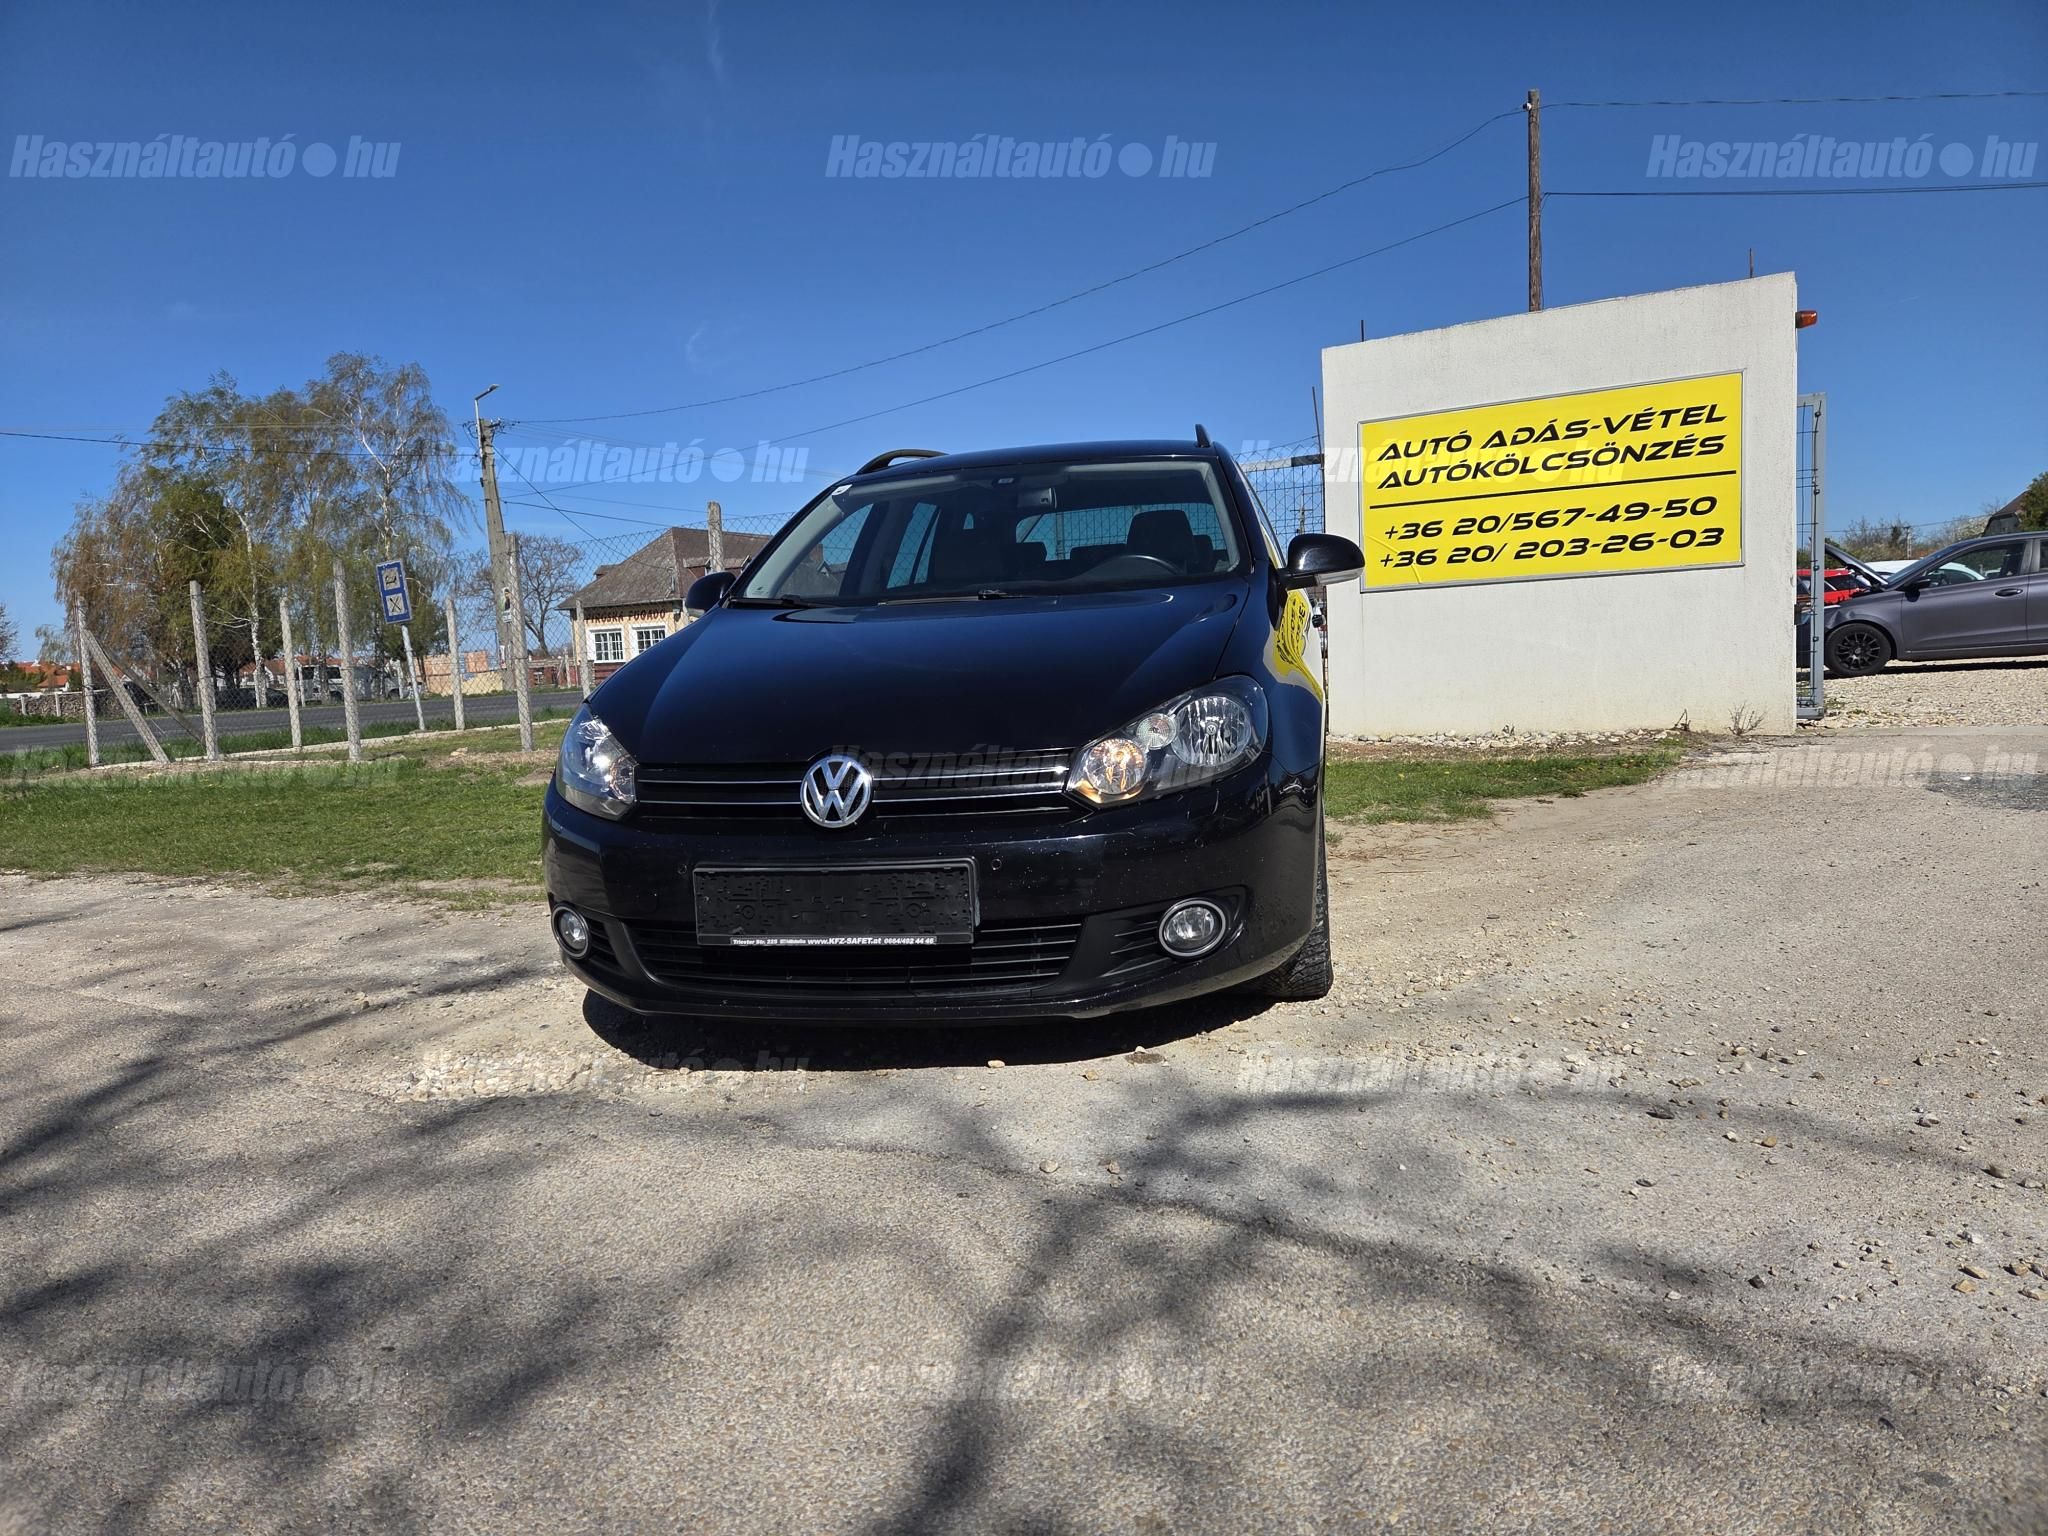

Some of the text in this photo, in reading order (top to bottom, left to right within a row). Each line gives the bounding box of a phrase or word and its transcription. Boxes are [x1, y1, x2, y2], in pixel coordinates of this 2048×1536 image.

[1377, 404, 1727, 461] AUTÓ ADÁS-VÉTEL
[1377, 434, 1727, 490] AUTÓKÖLCSÖNZÉS
[1384, 496, 1718, 540] +36 20/567-49-50
[1380, 527, 1725, 568] +36 20/ 203-26-03
